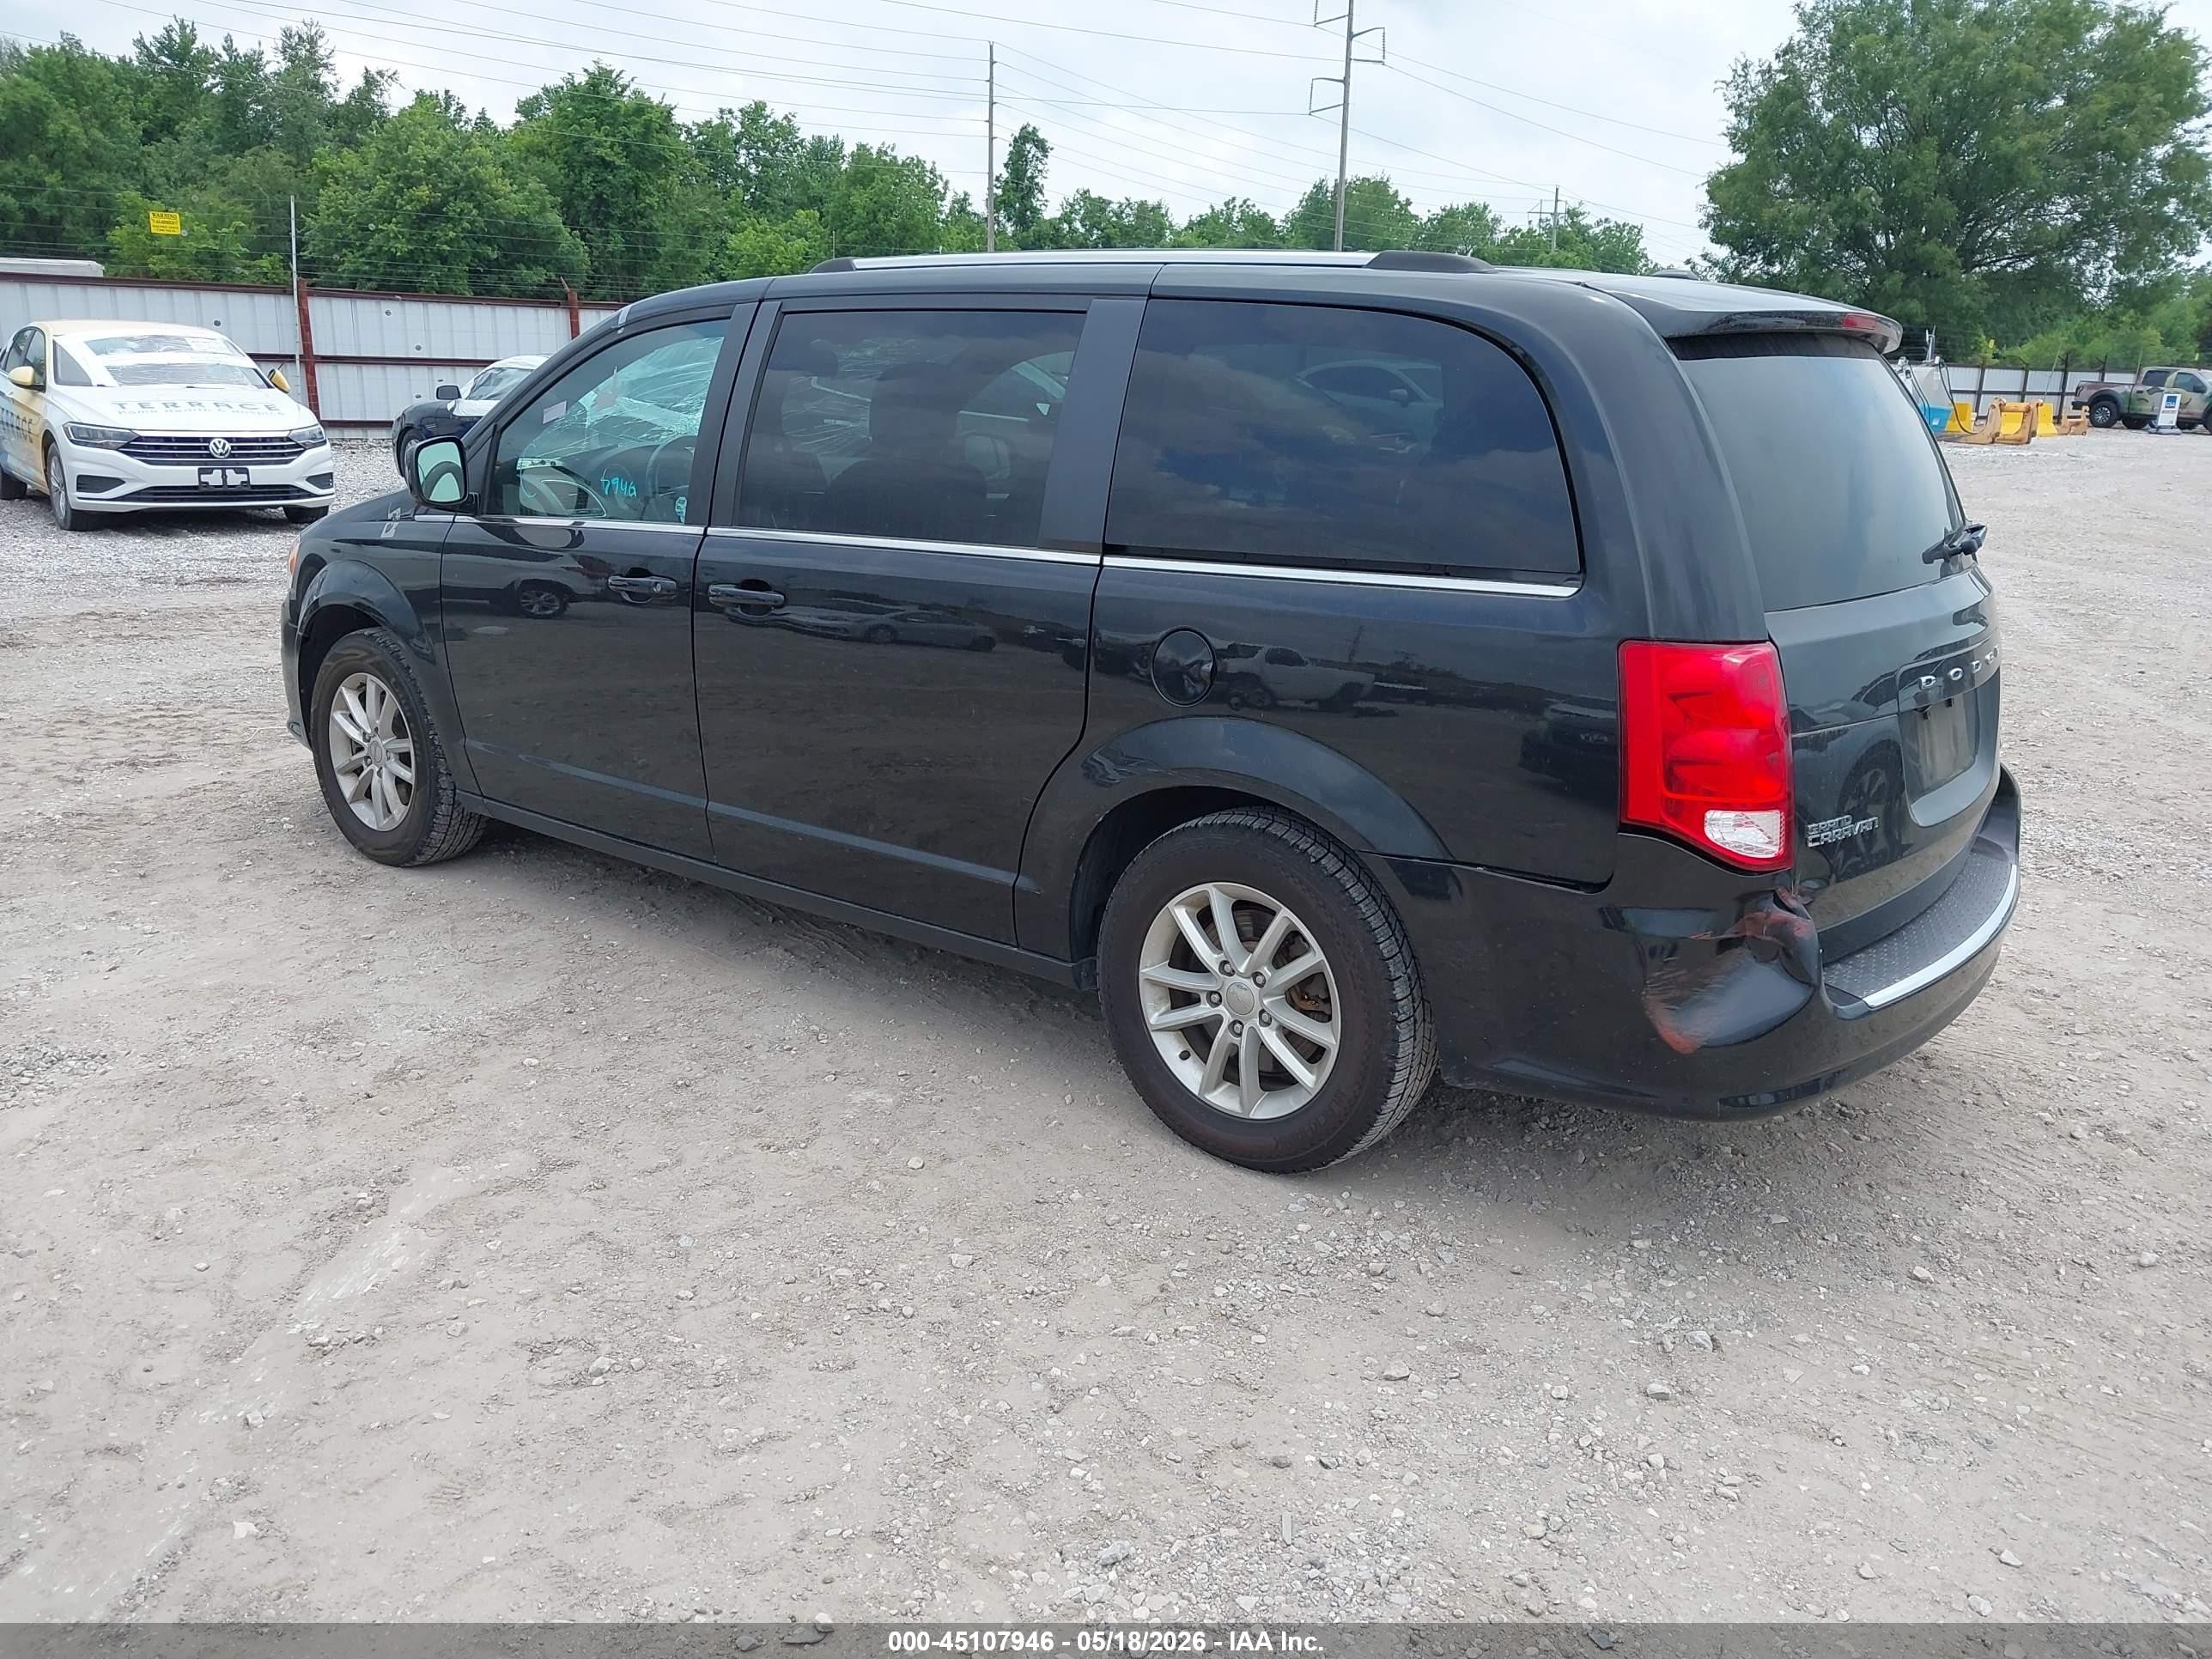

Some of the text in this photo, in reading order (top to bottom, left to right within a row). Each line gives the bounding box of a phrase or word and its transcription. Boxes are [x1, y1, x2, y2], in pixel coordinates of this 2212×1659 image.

[111, 401, 282, 412] TERRACE
[1807, 814, 1853, 836] GRAND
[1807, 817, 1879, 848] CARAVAN
